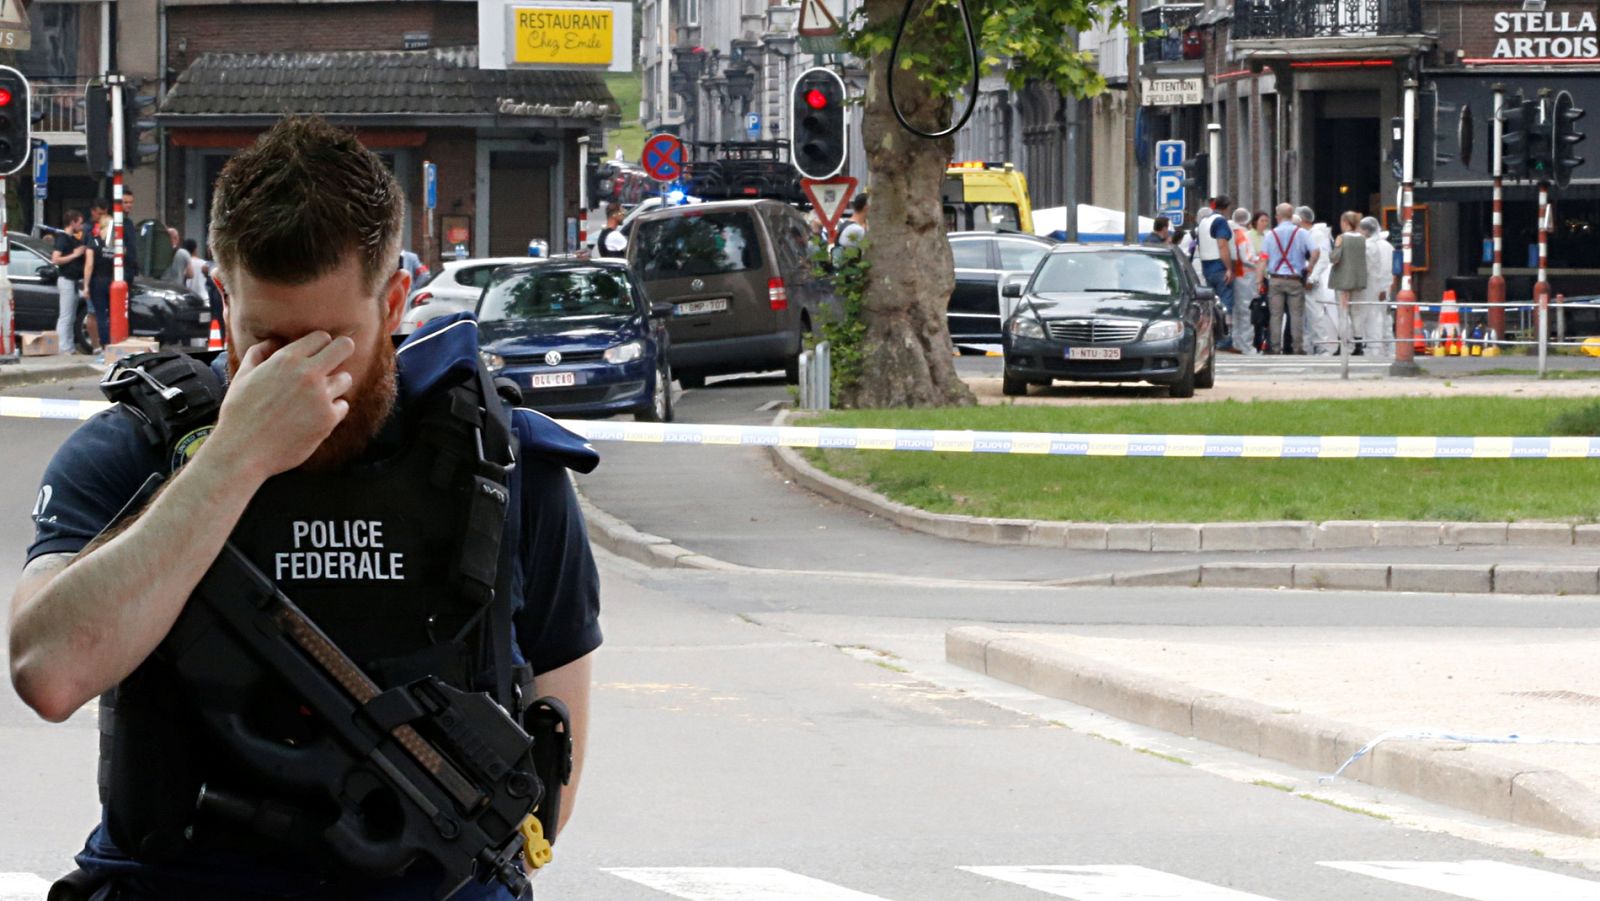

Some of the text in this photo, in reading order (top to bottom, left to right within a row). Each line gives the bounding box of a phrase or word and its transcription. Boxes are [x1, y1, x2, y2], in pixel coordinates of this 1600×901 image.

[520, 13, 609, 30] RESTAURANT
[1494, 11, 1597, 33] STELLA
[527, 30, 602, 57] Chez Emile
[1492, 37, 1598, 58] ARTOIS
[749, 115, 759, 129] P
[36, 147, 46, 178] P
[1161, 176, 1181, 209] P
[293, 520, 384, 549] POLICE
[275, 551, 405, 580] FEDERALE
